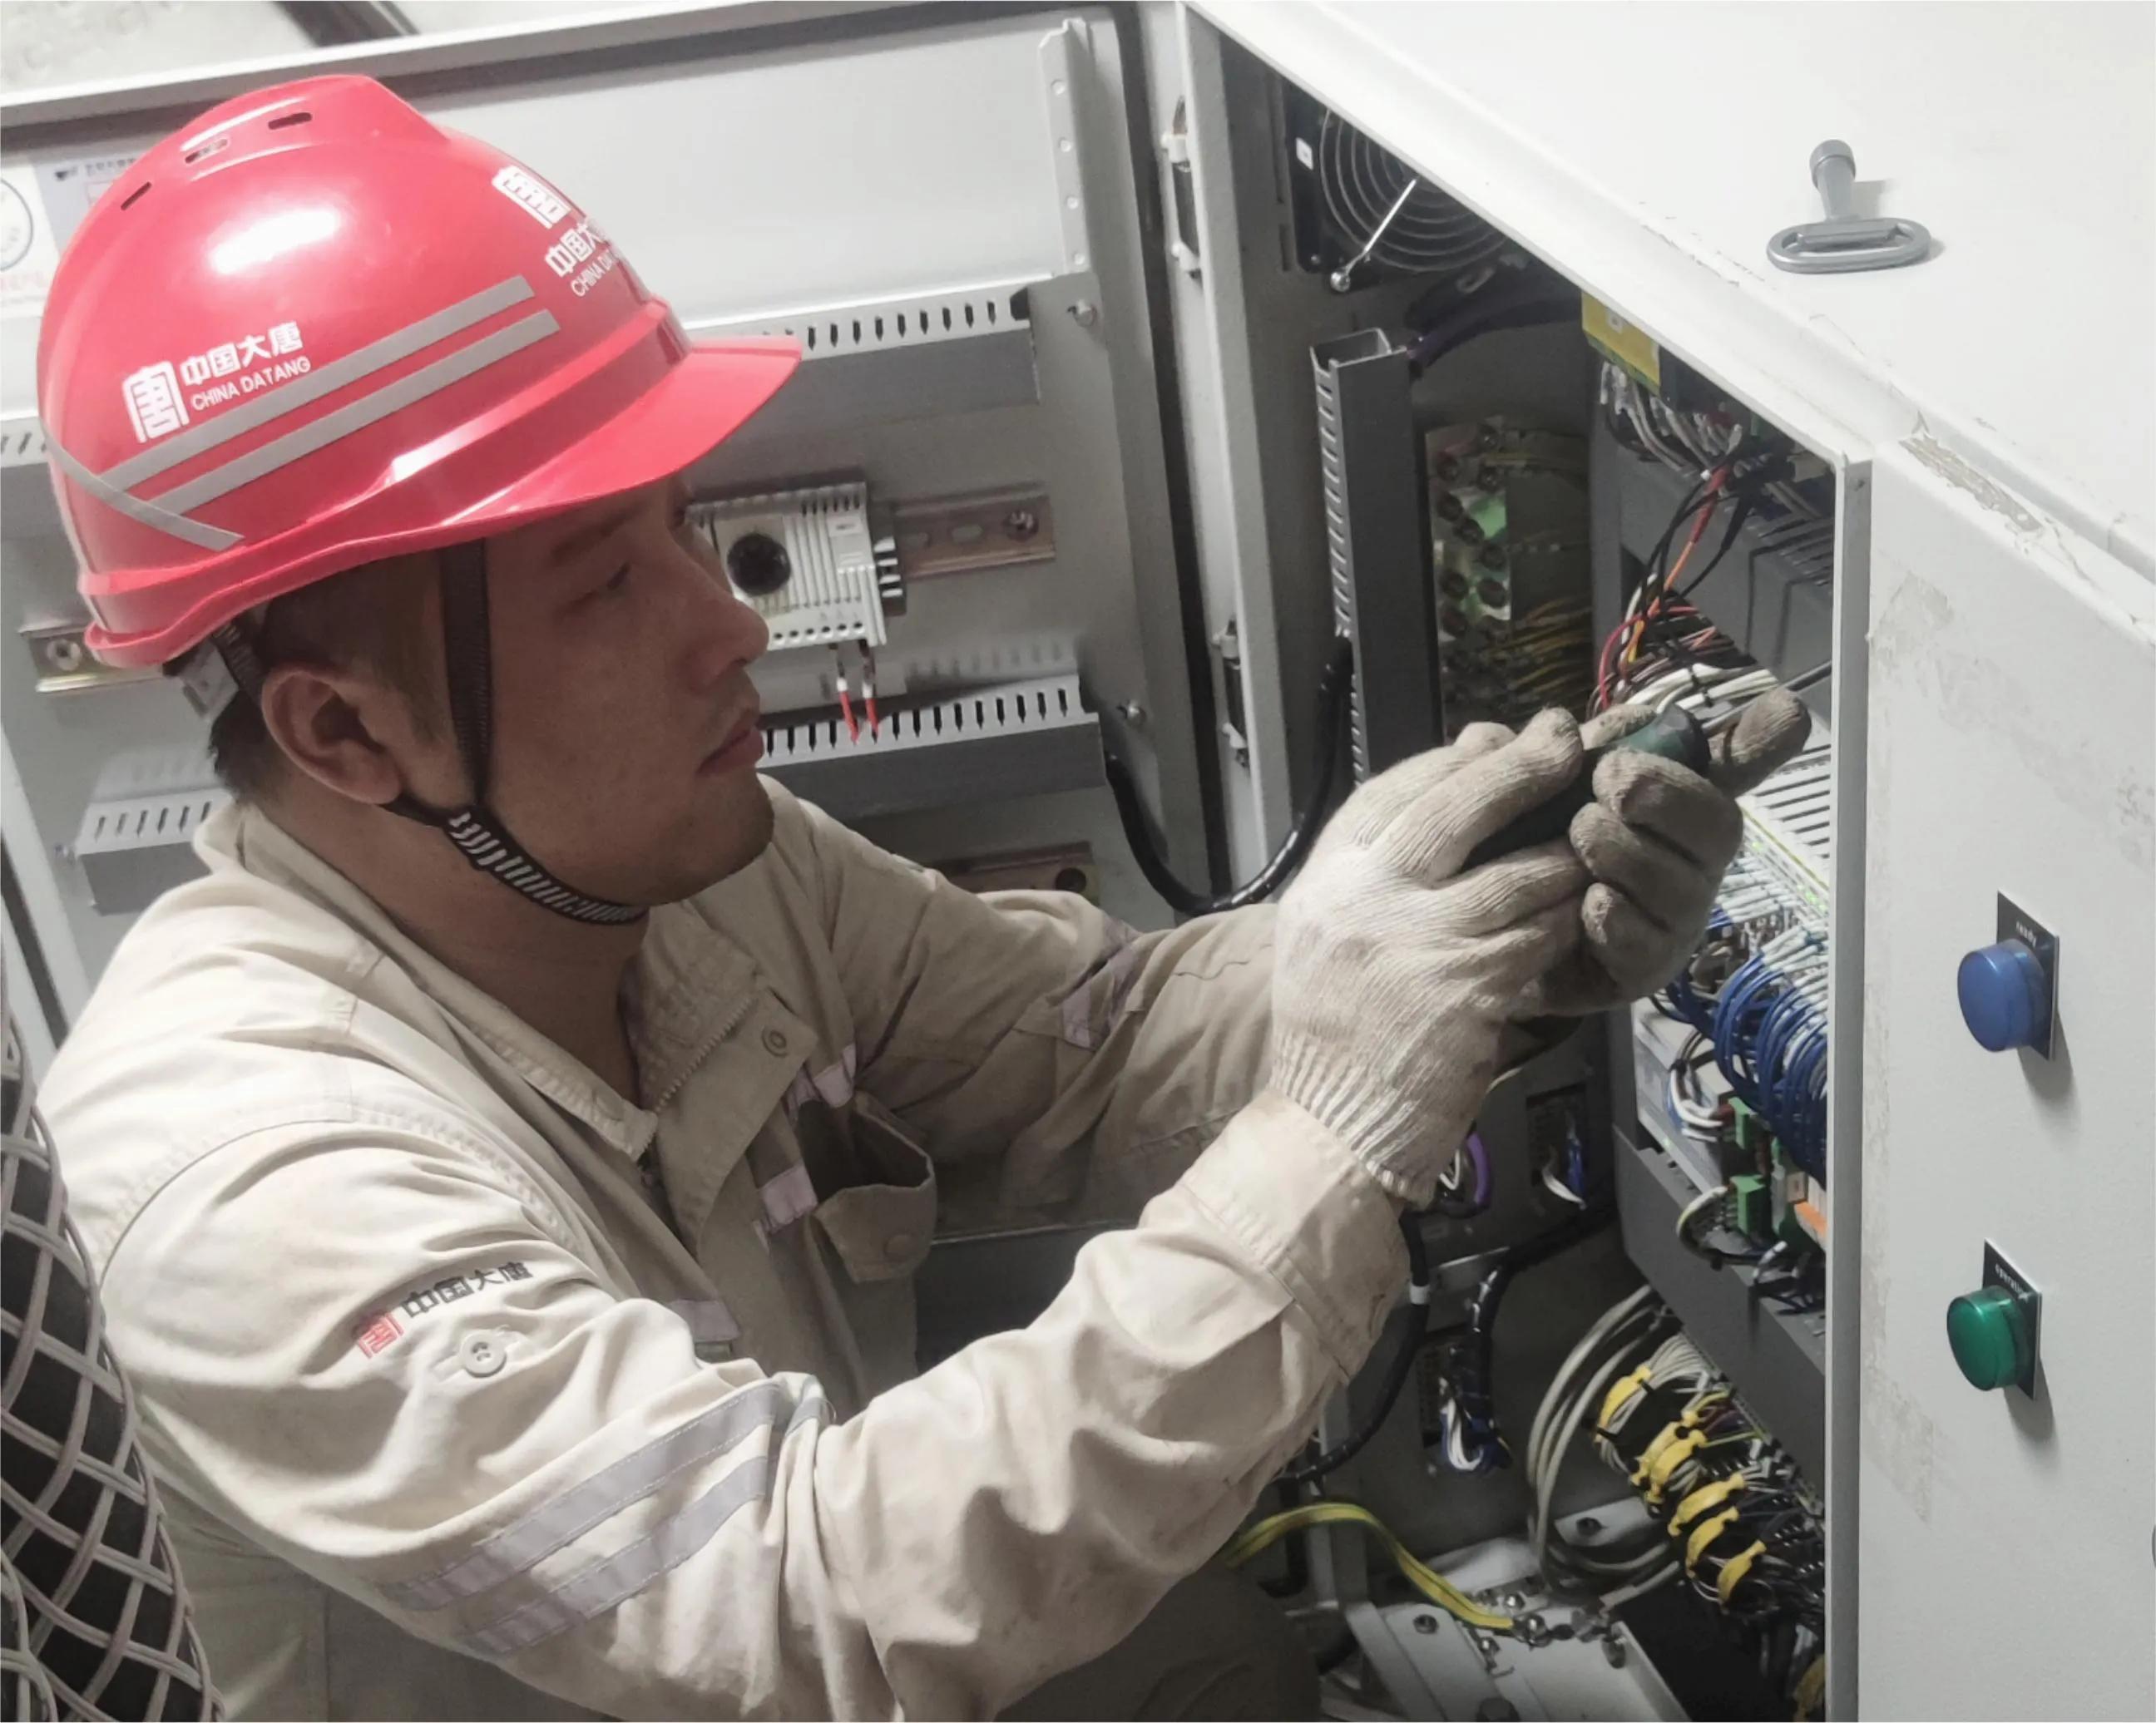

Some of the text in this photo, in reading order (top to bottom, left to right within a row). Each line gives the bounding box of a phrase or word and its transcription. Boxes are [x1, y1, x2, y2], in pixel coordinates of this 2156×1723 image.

[544, 222, 605, 278] 中国大
[571, 259, 606, 297] CHINA
[180, 321, 303, 386] 中国大唐
[191, 356, 311, 411] CHINA DATANG
[400, 1261, 533, 1318] 中国大唐
